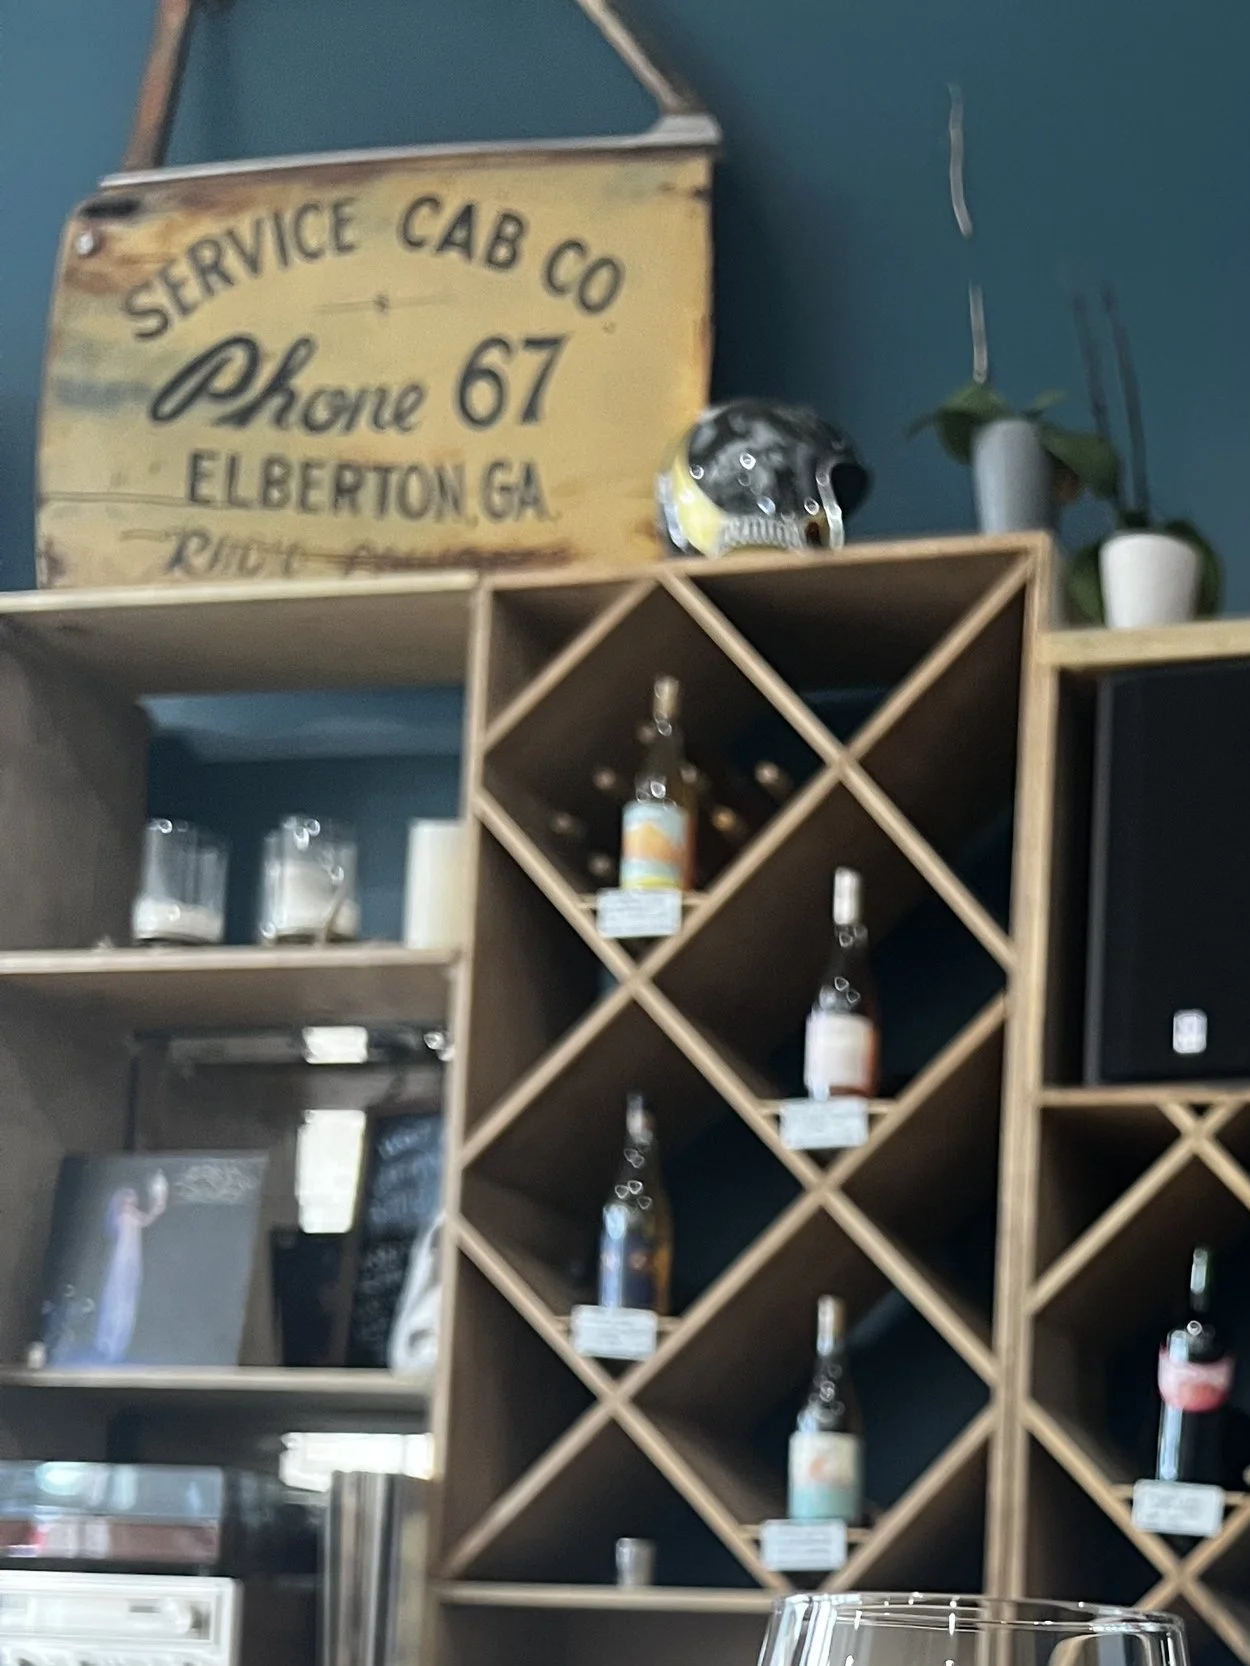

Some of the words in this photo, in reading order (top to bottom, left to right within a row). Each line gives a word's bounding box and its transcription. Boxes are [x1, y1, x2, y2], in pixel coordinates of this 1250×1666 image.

[120, 197, 359, 342] SERVICE
[398, 194, 529, 272] CAB
[541, 238, 626, 315] CO
[149, 332, 427, 435] Phone
[455, 334, 571, 429] 67
